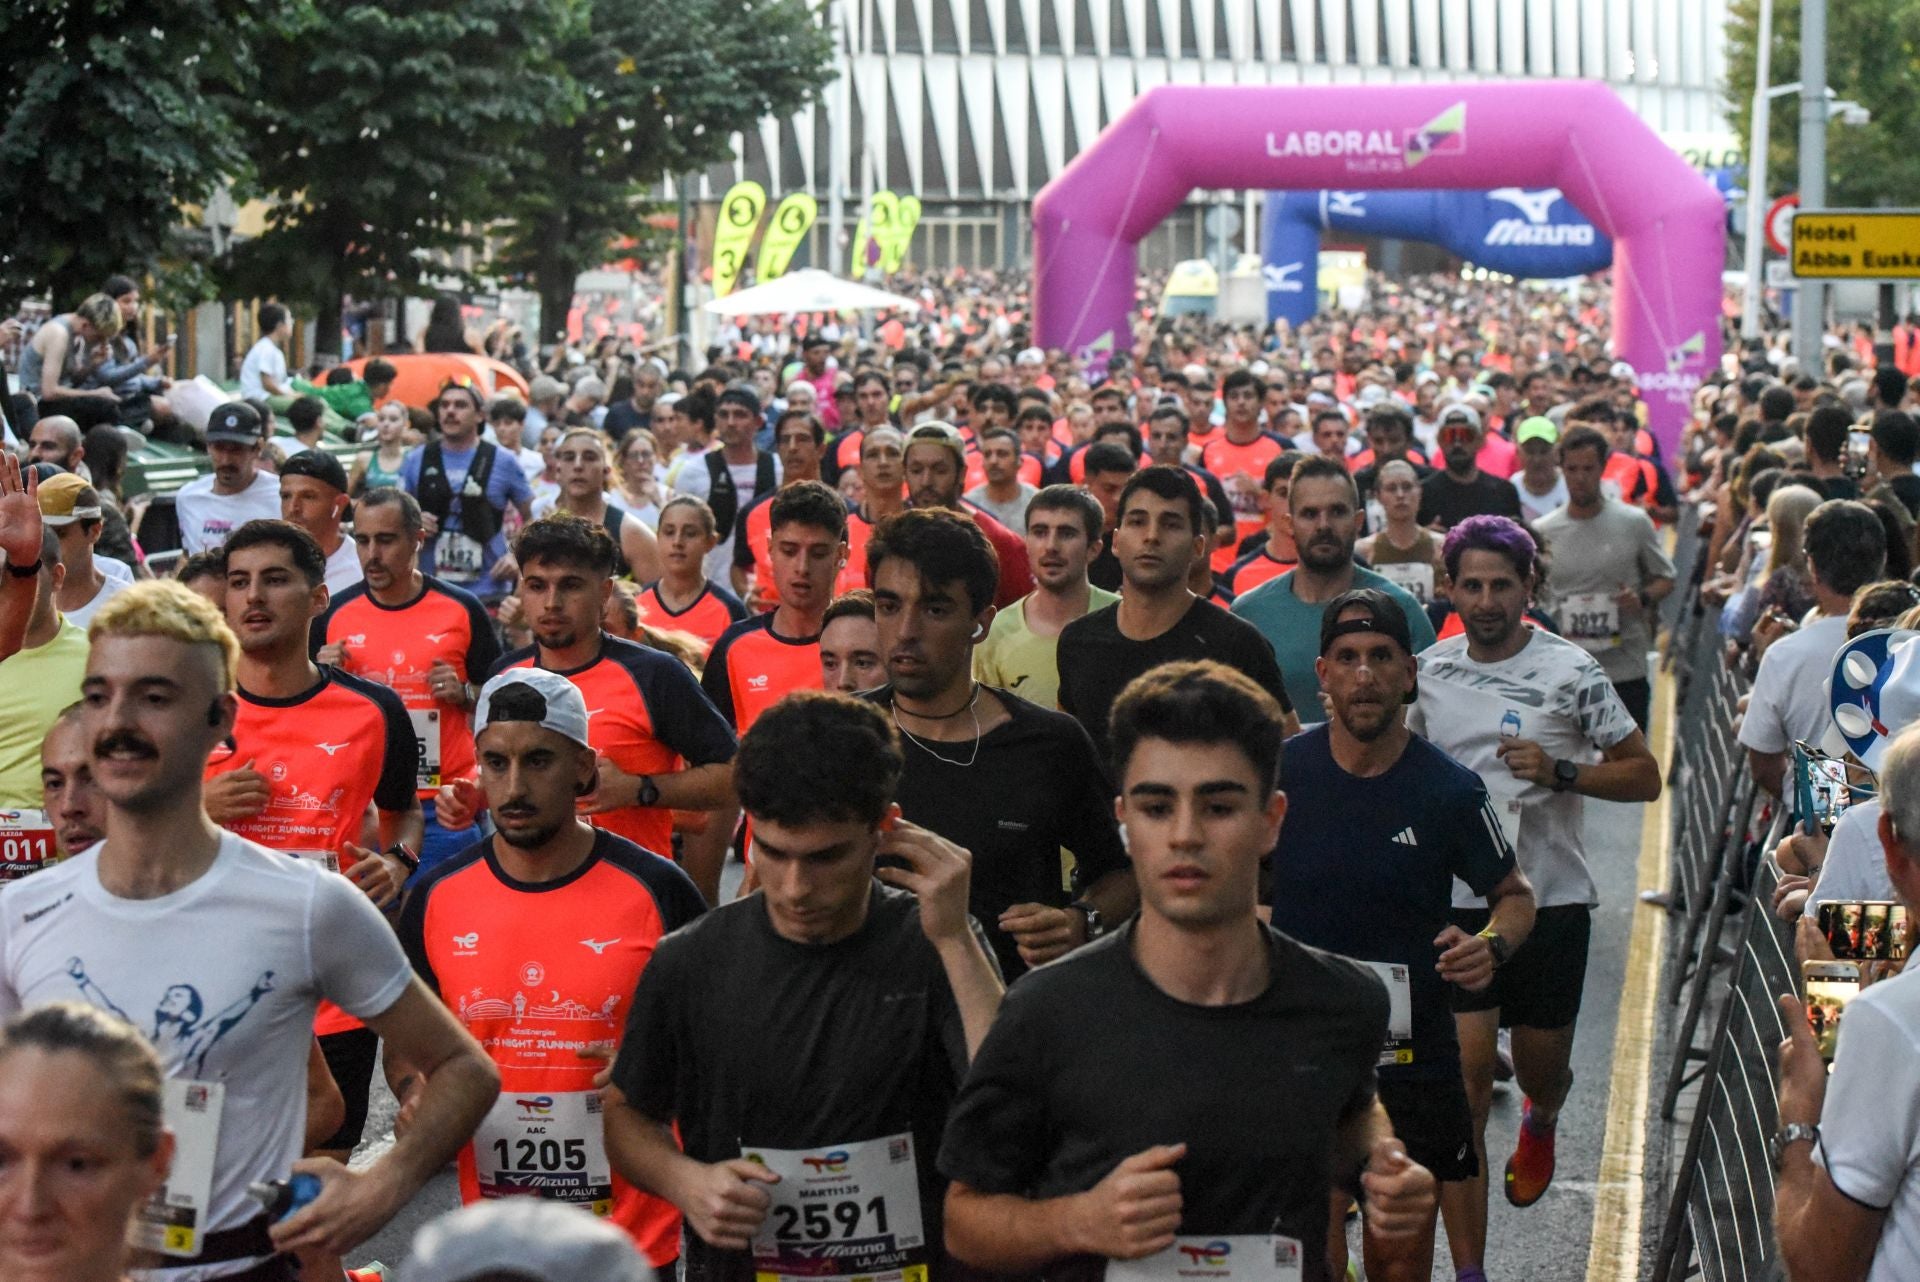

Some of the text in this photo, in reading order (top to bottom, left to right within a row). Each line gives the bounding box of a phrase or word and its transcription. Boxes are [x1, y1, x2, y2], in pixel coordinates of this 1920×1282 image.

[1266, 130, 1401, 157] LABORAL
[1797, 224, 1856, 241] Hotel
[1798, 250, 1852, 266] Abba
[502, 1038, 533, 1048] NIGHT
[537, 1039, 585, 1050] RUNNING
[494, 1138, 587, 1171] 1205
[555, 1188, 569, 1197] LA
[773, 1196, 888, 1241] 2591
[856, 1256, 873, 1267] LA
